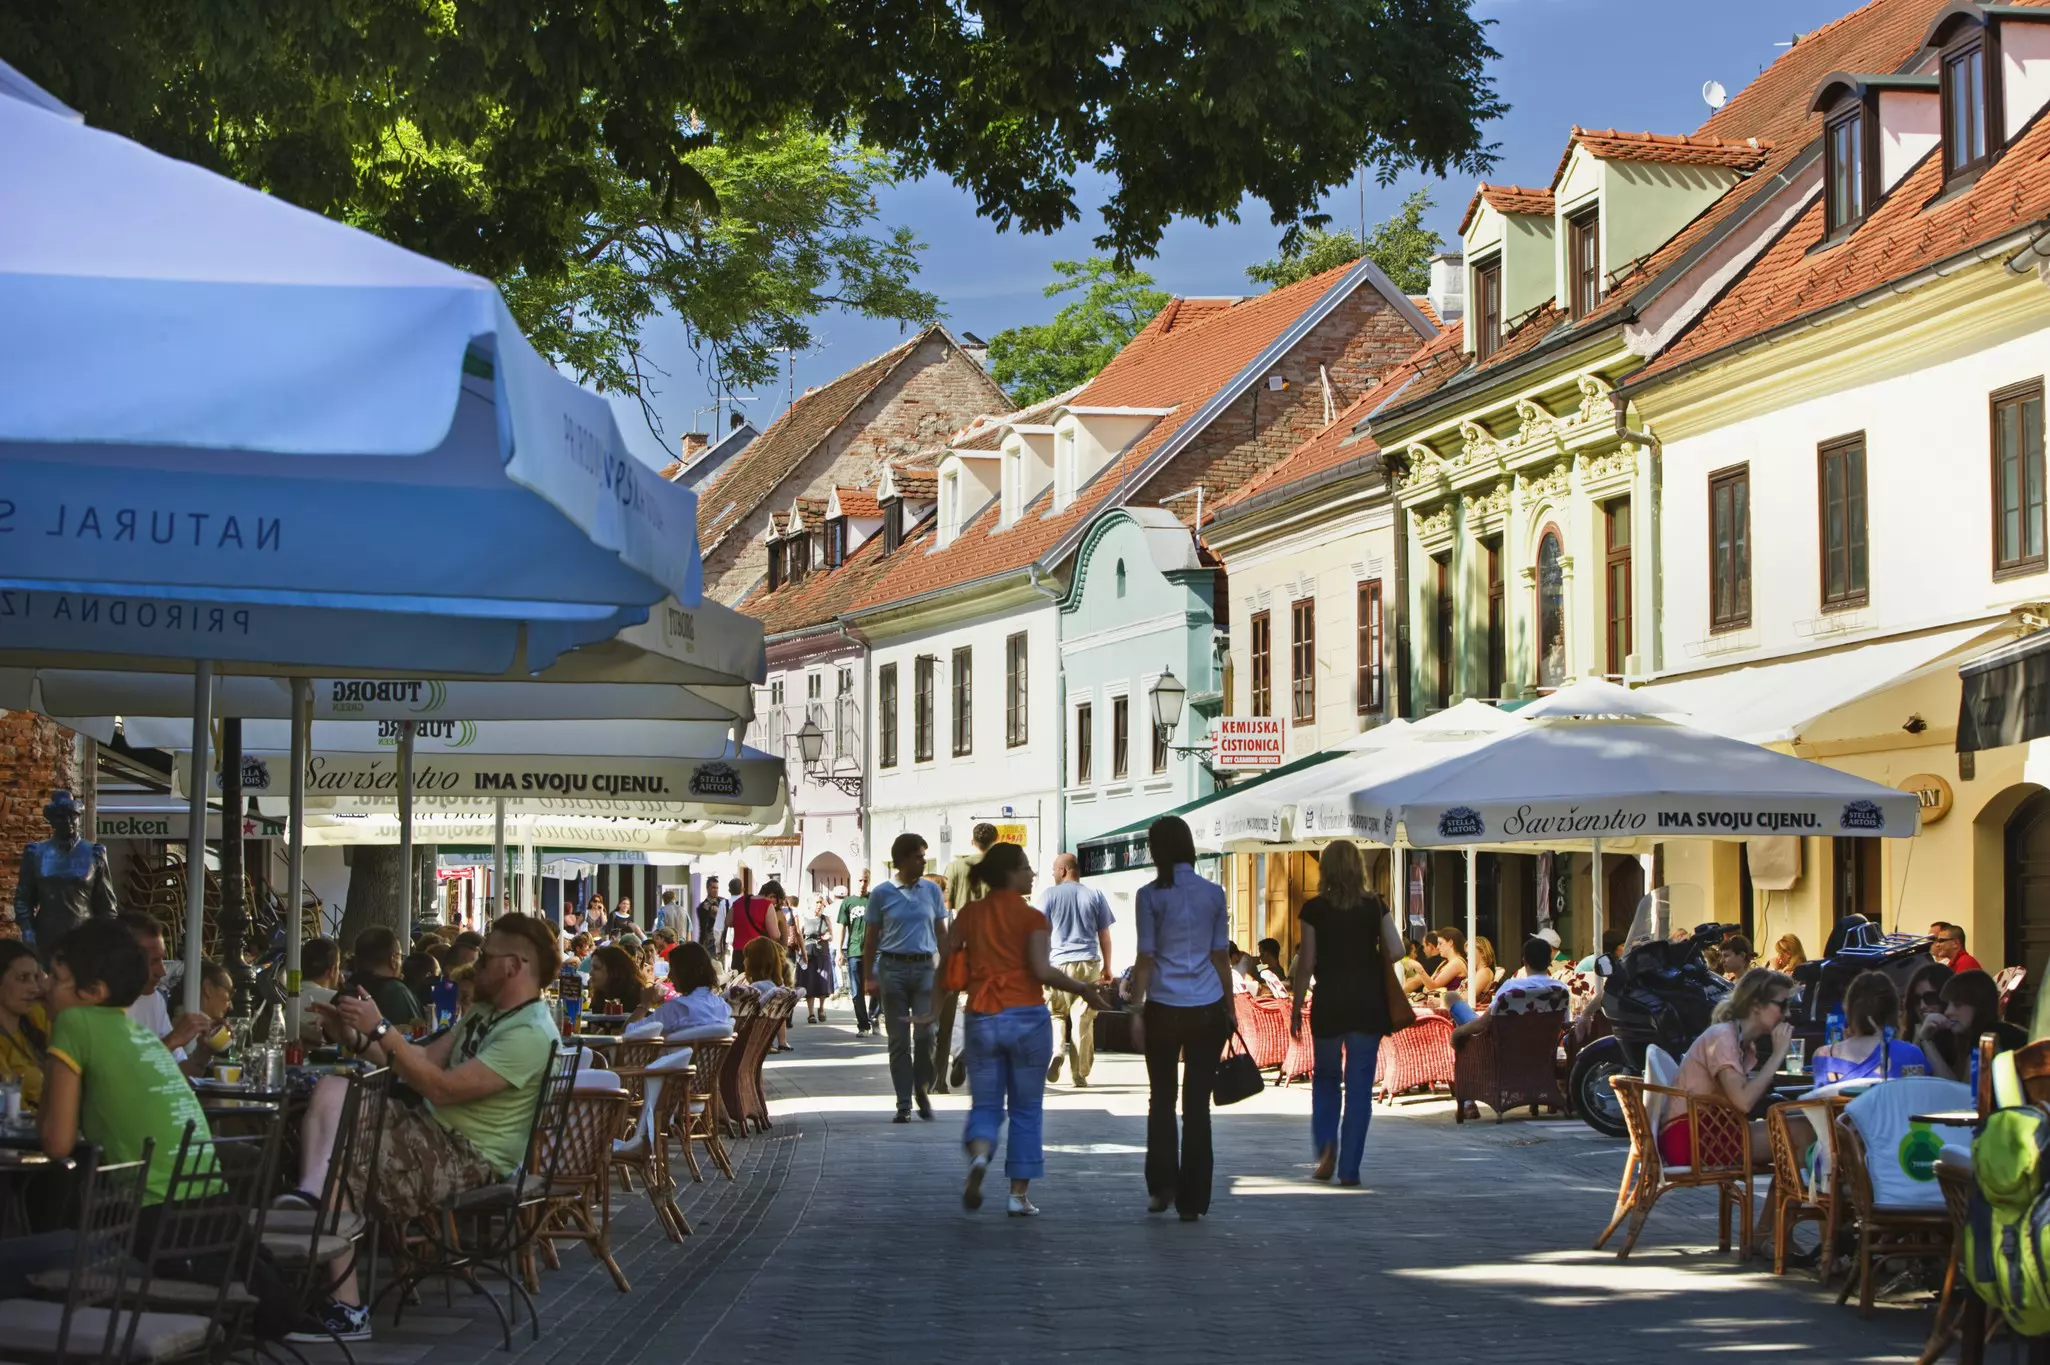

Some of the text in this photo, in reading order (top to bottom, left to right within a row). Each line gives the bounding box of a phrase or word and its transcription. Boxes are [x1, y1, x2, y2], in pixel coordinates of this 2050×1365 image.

[1222, 721, 1278, 733] KEMIJSKA
[1222, 736, 1279, 751] ČISTIONICA
[305, 757, 671, 796] Savršentvo IMA SVOJU CIJENU.
[700, 776, 733, 784] STELLA
[699, 783, 733, 791] ARTOIS
[96, 817, 169, 835] ineken
[1503, 804, 1822, 836] Savršenstvo IMA SVOJU CIJENU.
[1447, 825, 1477, 833] ARTOIS
